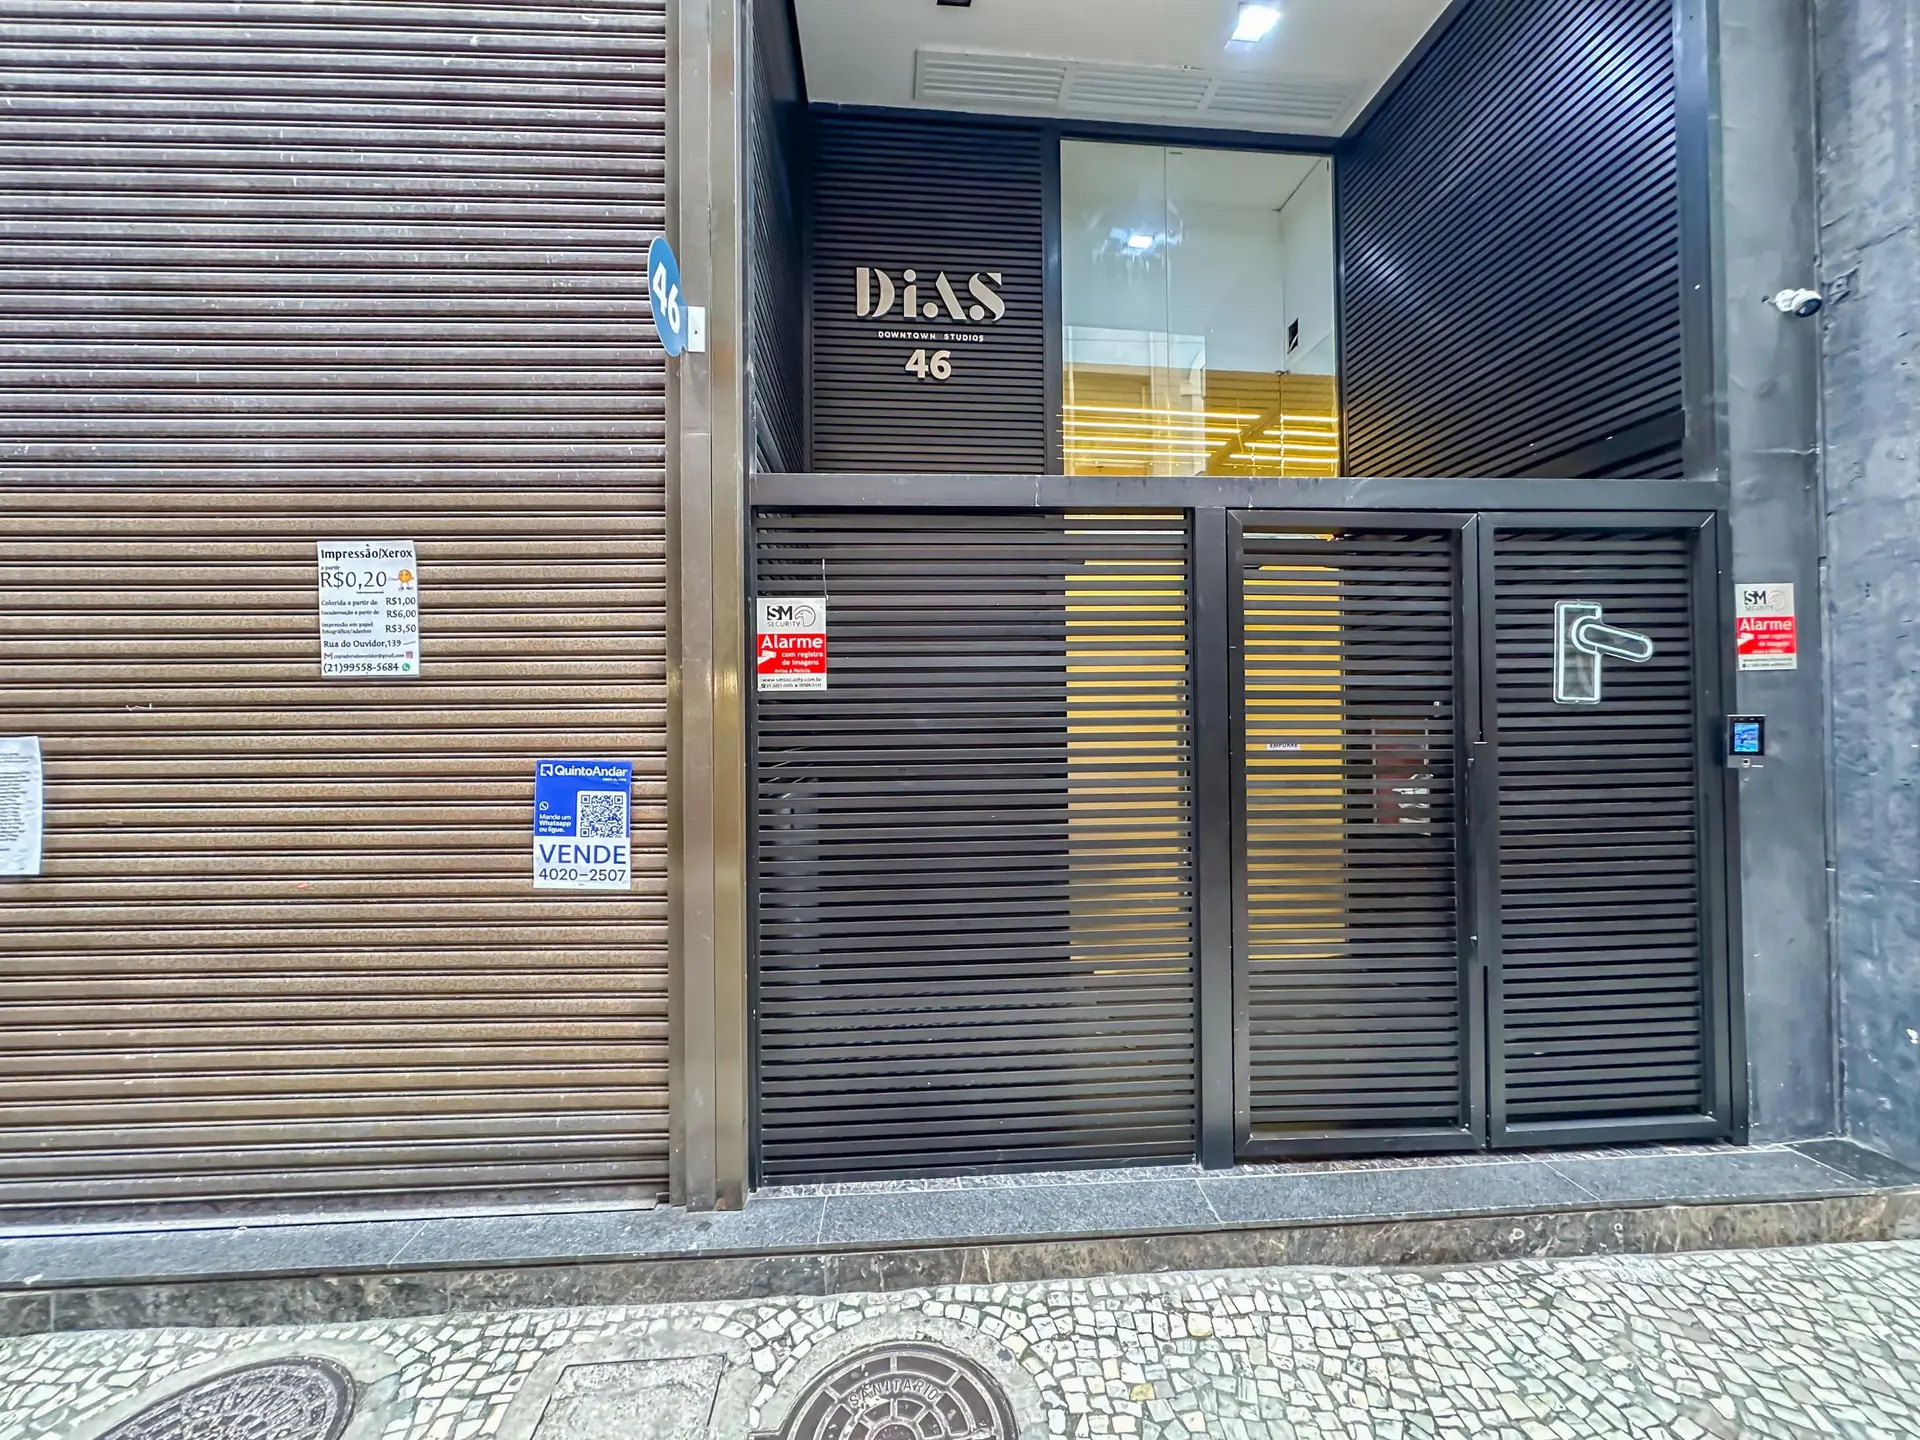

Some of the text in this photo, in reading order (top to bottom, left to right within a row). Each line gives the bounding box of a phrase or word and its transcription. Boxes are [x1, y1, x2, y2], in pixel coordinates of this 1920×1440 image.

[652, 261, 680, 334] 46
[878, 331, 984, 342] DOWNTOWN STUDIOS
[905, 349, 951, 380] 46
[320, 571, 387, 590] R$0,20
[385, 597, 416, 606] R$1,00
[1744, 590, 1766, 605] SM
[386, 609, 416, 619] R$6,00
[767, 606, 792, 620] SM
[385, 624, 416, 634] R$3,50
[1740, 618, 1792, 631] Alarme
[323, 640, 401, 648] Rua do Ouvidor,139
[761, 634, 823, 648] Alarme
[323, 662, 399, 673] (21)99558-5684
[554, 765, 628, 777] QuintoAndar
[539, 820, 572, 828] Whatsapp
[539, 844, 626, 865] VENDE
[539, 868, 626, 881] 4020-2507
[849, 1379, 939, 1407] SANITARIO
